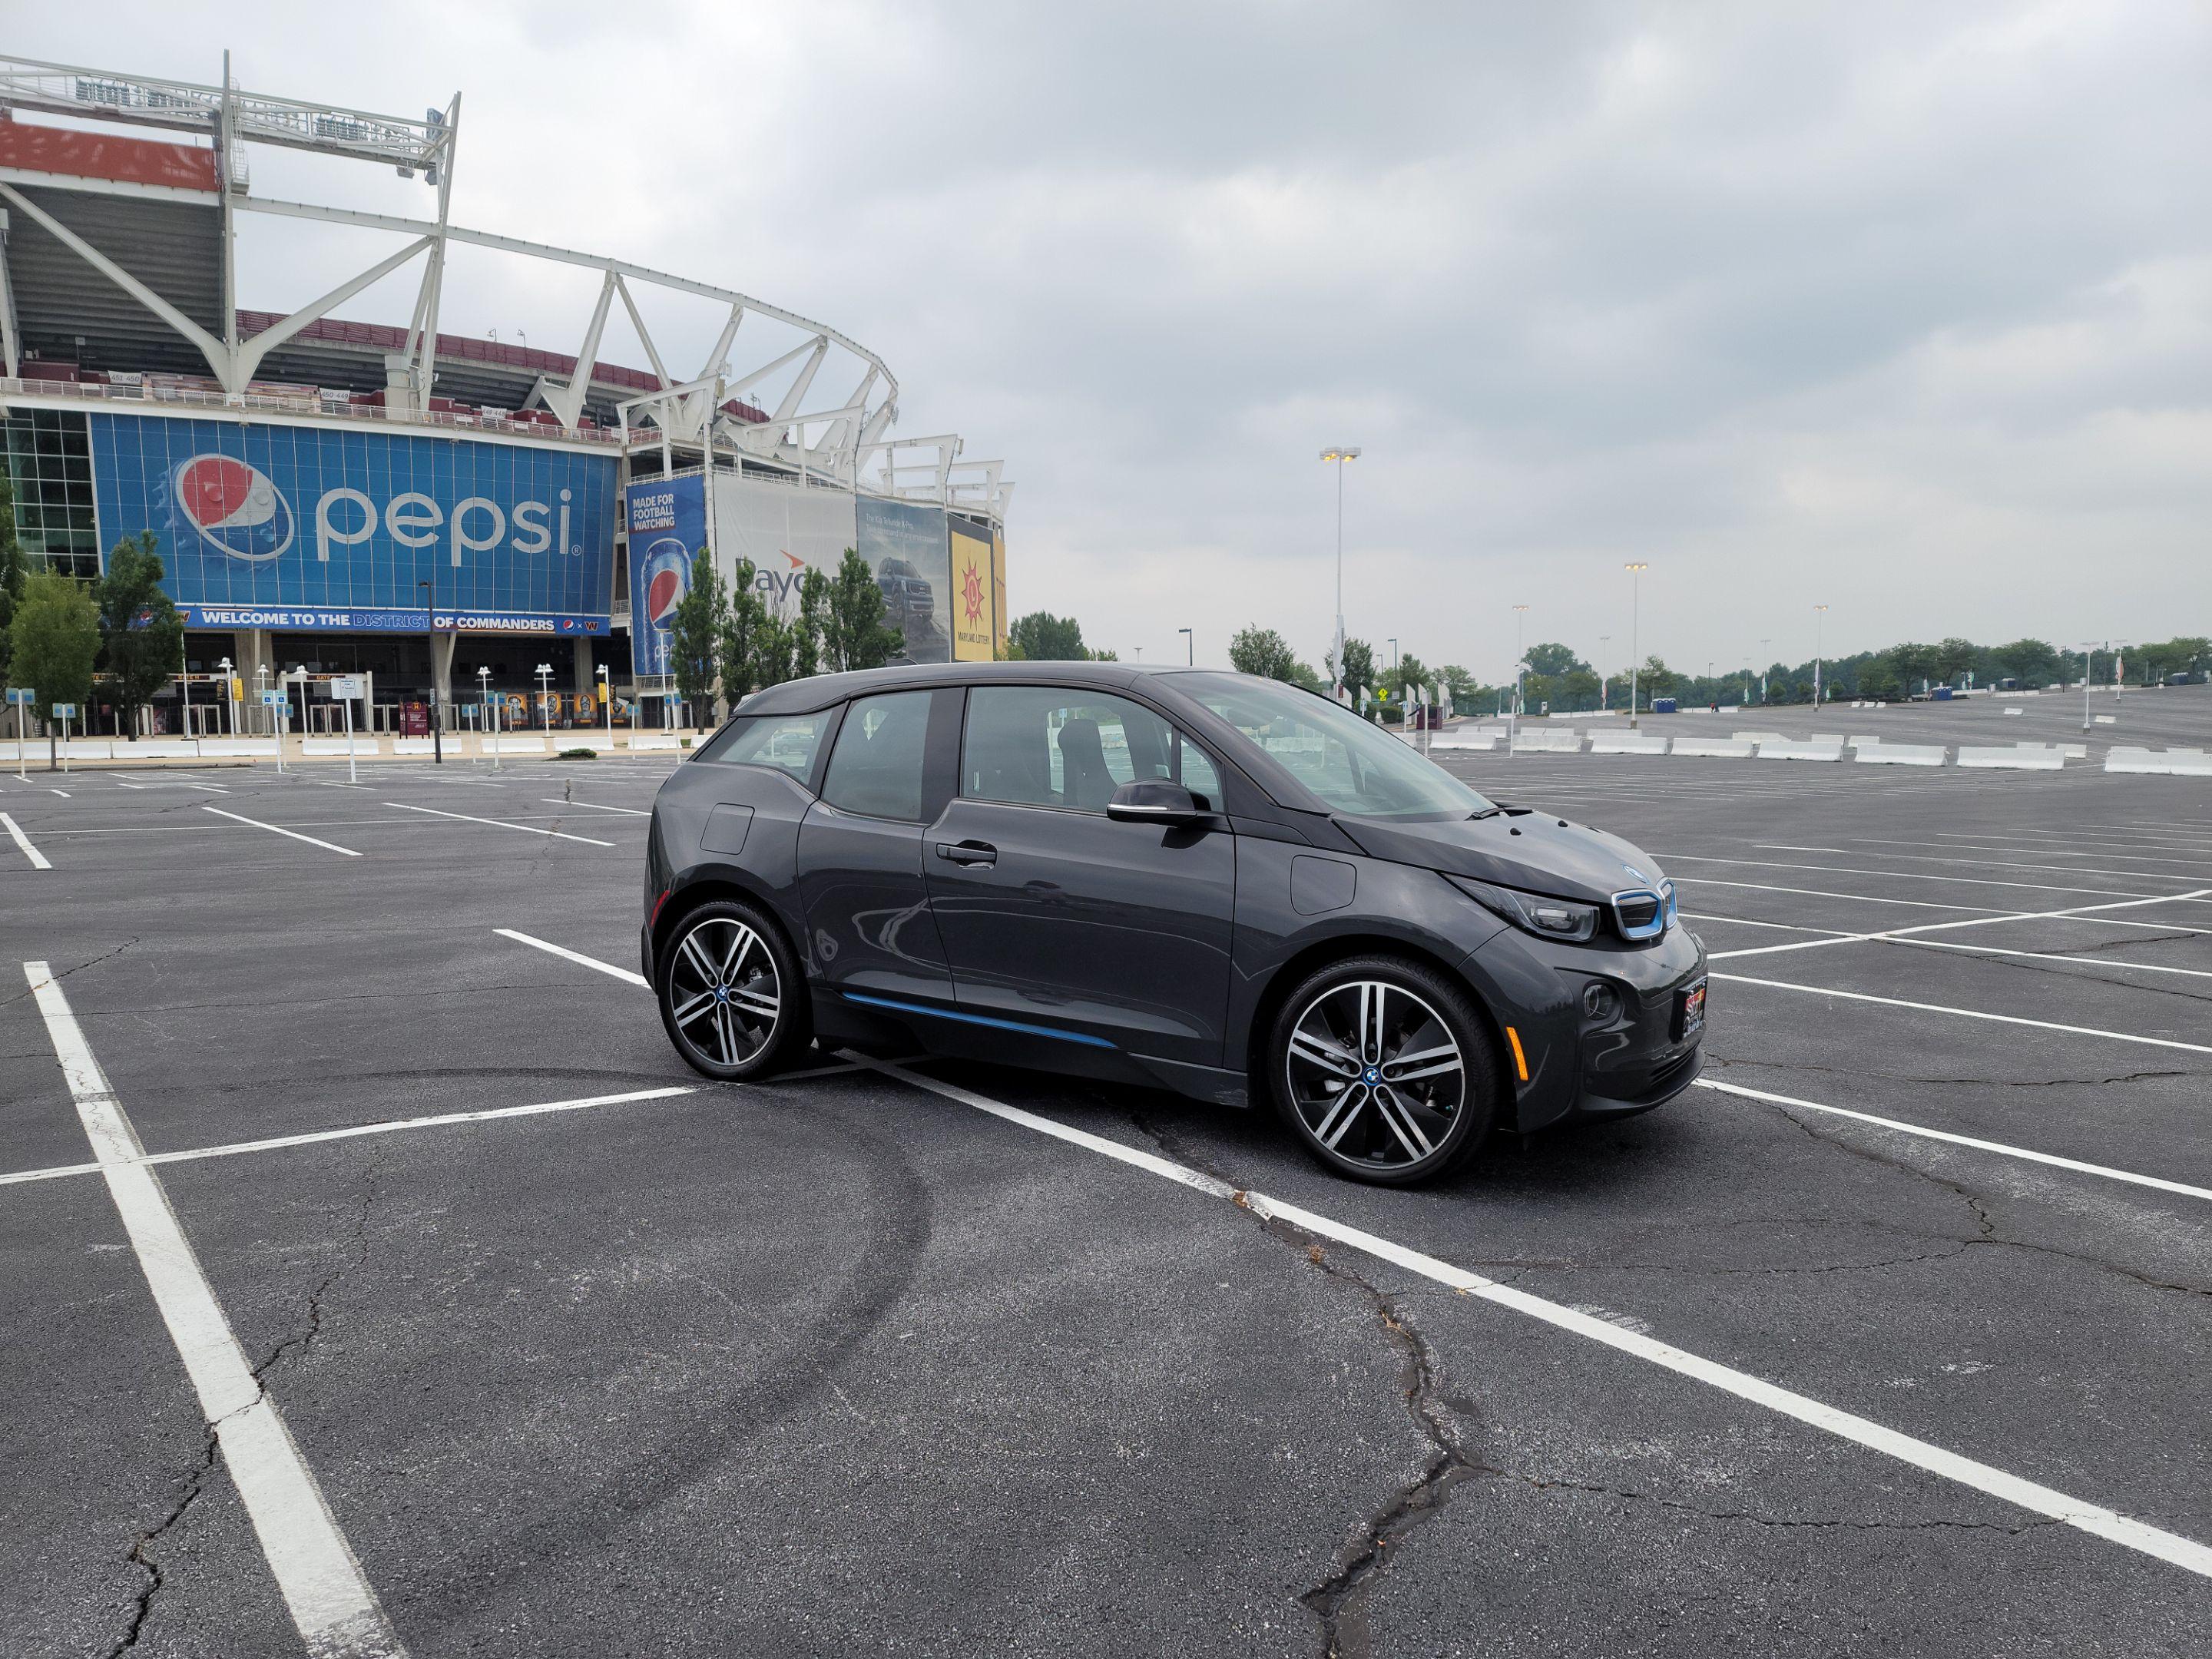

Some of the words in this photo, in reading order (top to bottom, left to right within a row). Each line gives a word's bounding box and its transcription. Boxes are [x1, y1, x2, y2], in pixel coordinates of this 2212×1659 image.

[633, 496, 656, 508] MADE
[657, 494, 674, 505] FOR
[634, 505, 674, 520] FOOTBALL
[316, 488, 572, 567] pepsi
[634, 516, 675, 531] WATCHING
[202, 611, 289, 624] WELCOME
[293, 614, 315, 625] TO
[318, 614, 350, 626] THE
[353, 614, 430, 628] DISTRICT
[434, 616, 454, 628] OF
[456, 618, 555, 631] COMMANDERS
